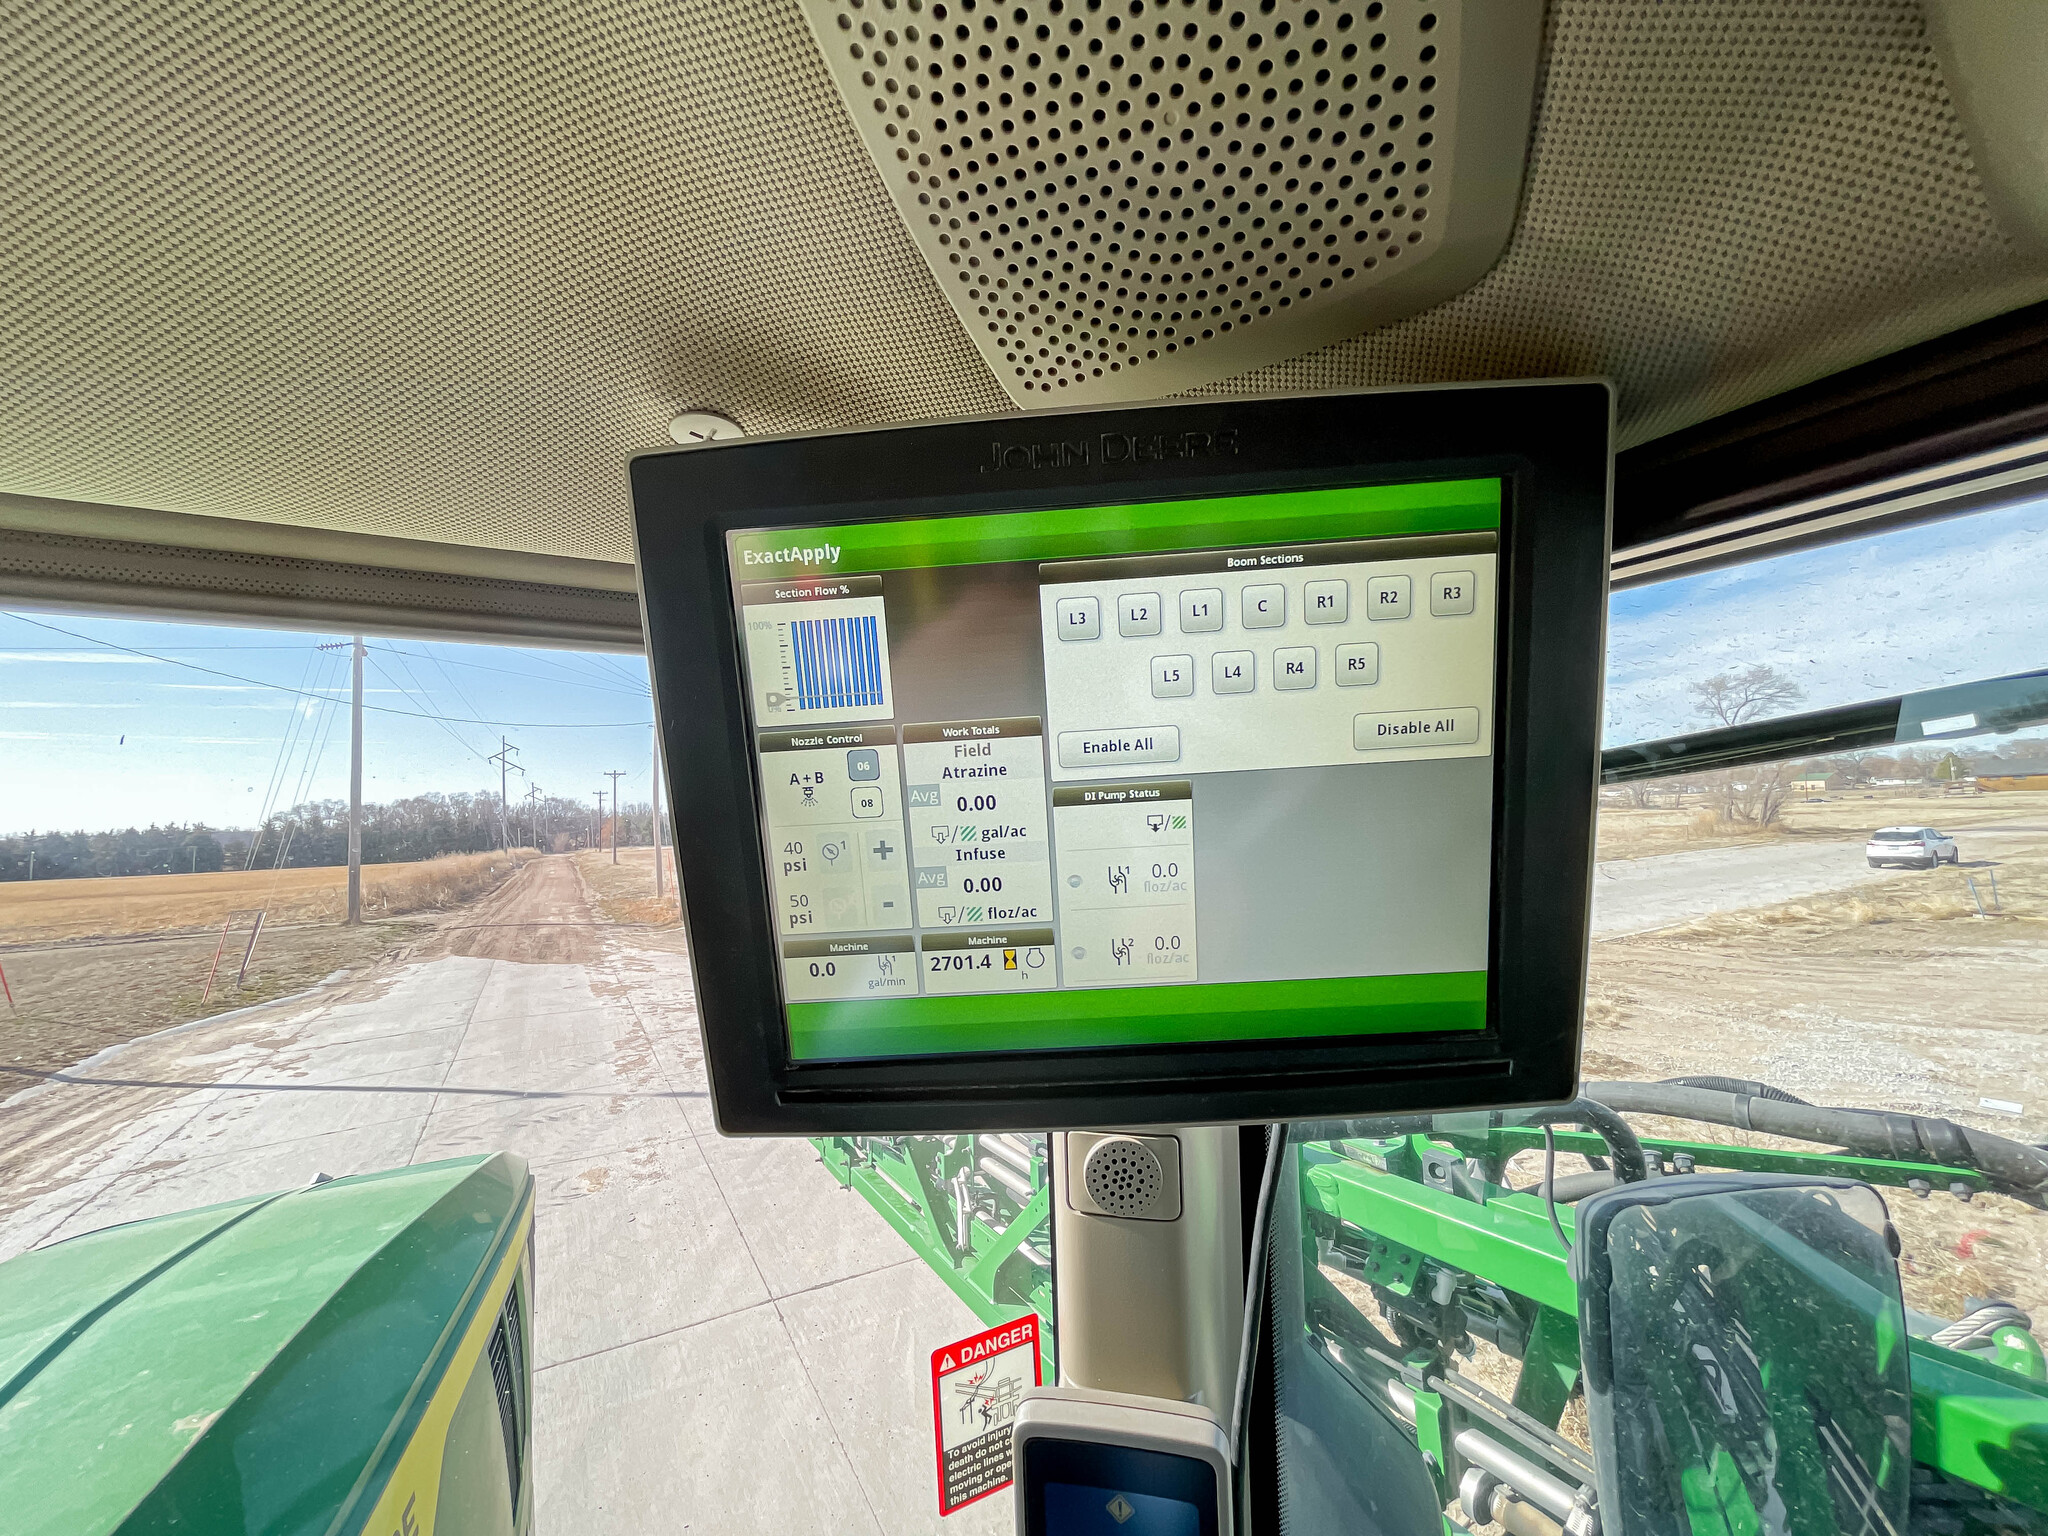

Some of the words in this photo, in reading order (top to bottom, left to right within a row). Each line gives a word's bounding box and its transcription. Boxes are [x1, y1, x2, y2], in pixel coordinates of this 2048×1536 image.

[981, 441, 1089, 473] JOHN
[743, 544, 841, 565] ExactApply
[1227, 556, 1257, 567] Boom
[1260, 553, 1304, 565] Sections
[775, 587, 812, 599] Section
[814, 586, 837, 596] Flow
[840, 585, 850, 594] %
[1380, 591, 1398, 604] R2
[1443, 586, 1461, 600] R3
[1258, 600, 1268, 612] C
[1317, 596, 1334, 608] R1
[1130, 608, 1148, 621] L2
[1192, 604, 1208, 617] L1
[748, 620, 773, 632] 100%
[1070, 612, 1086, 626] L3
[1286, 662, 1304, 674] R4
[1348, 658, 1365, 670] R5
[1164, 670, 1180, 682] L5
[1225, 666, 1242, 678] L4
[942, 726, 969, 737] Work
[971, 725, 1000, 735] Totals
[1377, 720, 1431, 736] Disable
[1434, 719, 1454, 733] All
[791, 736, 824, 746] Nozzle
[826, 734, 863, 744] Control
[1083, 739, 1130, 754] Enable
[1132, 737, 1153, 751] All
[954, 743, 992, 758] Field
[856, 761, 870, 771] 06
[942, 764, 1007, 780] Atrazine
[790, 773, 800, 785] A
[815, 772, 824, 783] B
[911, 788, 939, 806] Avg
[1084, 792, 1096, 801] DI
[1099, 791, 1126, 801] Pump
[1129, 789, 1160, 799] Status
[861, 799, 874, 808] 08
[957, 795, 996, 812] 0.00
[981, 825, 1027, 841] gal/ac
[784, 841, 803, 855] 40
[956, 847, 1006, 862] Infuse
[784, 858, 807, 876] psi
[1152, 863, 1178, 878] 0.0
[918, 870, 946, 887] Avg
[963, 877, 1002, 893] 0.00
[1144, 881, 1188, 893] floz/ac
[790, 894, 808, 908] 50
[790, 910, 813, 928] psi
[987, 905, 1037, 921] floz/ac
[829, 942, 868, 952] Machine
[968, 935, 1008, 945] Machine
[1155, 936, 1181, 950] 0.0
[930, 955, 992, 972] 2701.4
[1147, 953, 1190, 965] floz/ac
[809, 962, 836, 977] 0.0
[1021, 971, 1028, 980] h
[868, 977, 906, 988] gal/min
[961, 1323, 1033, 1364] DANGER
[948, 1449, 959, 1459] To
[962, 1436, 985, 1454] avoid
[988, 1426, 1012, 1442] injury
[949, 1454, 973, 1470] death
[975, 1449, 986, 1459] do
[989, 1441, 1003, 1453] not
[949, 1461, 981, 1482] electric
[983, 1452, 1004, 1467] lines
[950, 1473, 982, 1494] moving
[985, 1468, 994, 1478] or
[950, 1493, 967, 1506] this
[969, 1474, 1008, 1498] machine.
